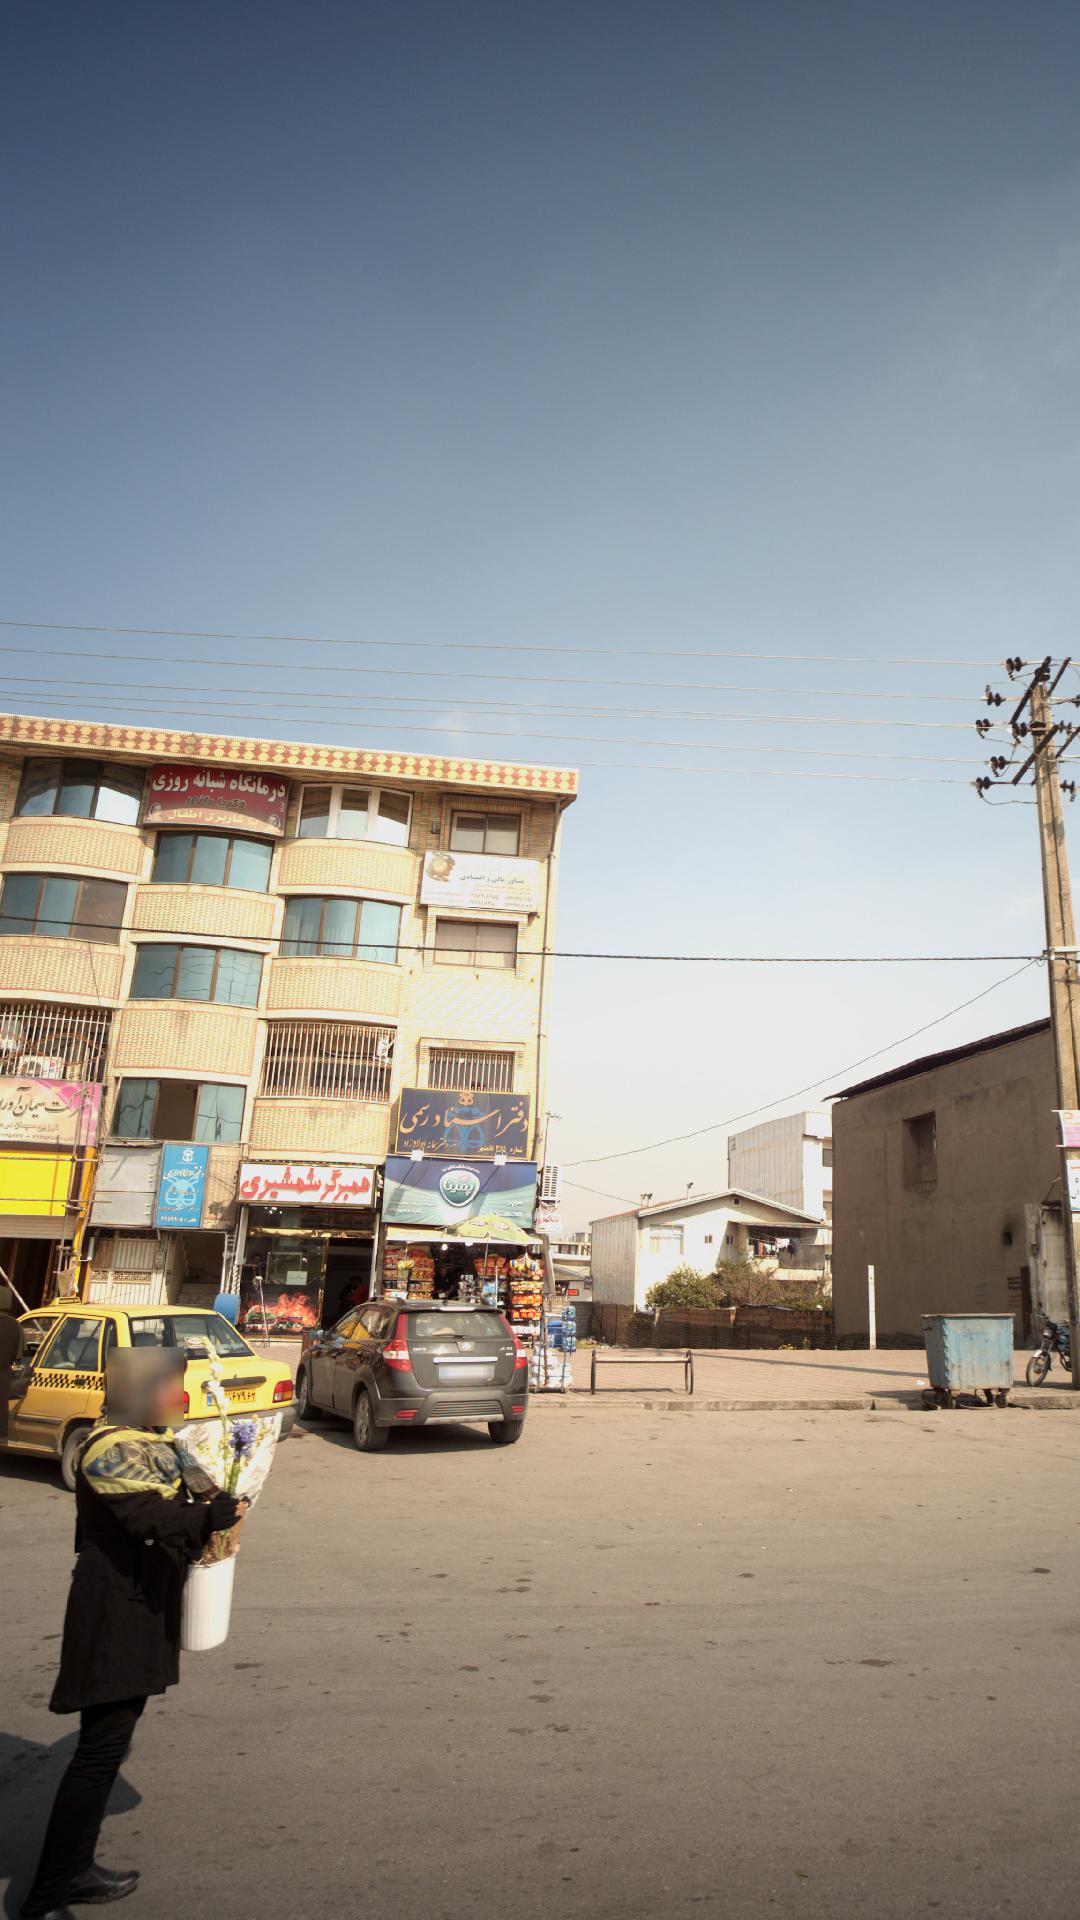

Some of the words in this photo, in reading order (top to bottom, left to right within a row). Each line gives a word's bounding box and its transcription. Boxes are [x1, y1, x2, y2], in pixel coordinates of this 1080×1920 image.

[152, 772, 189, 792] روزی
[193, 769, 226, 793] شبانه
[229, 773, 286, 802] درمانگاه
[168, 810, 203, 820] اطفال
[12, 1098, 46, 1119] سیمان
[44, 1086, 90, 1118] شرکت
[400, 1103, 430, 1134] رسمی
[432, 1106, 502, 1129] اسناد
[494, 1101, 529, 1138] دفتر
[240, 1166, 322, 1200] شمشیری
[320, 1169, 370, 1201] همبرگر
